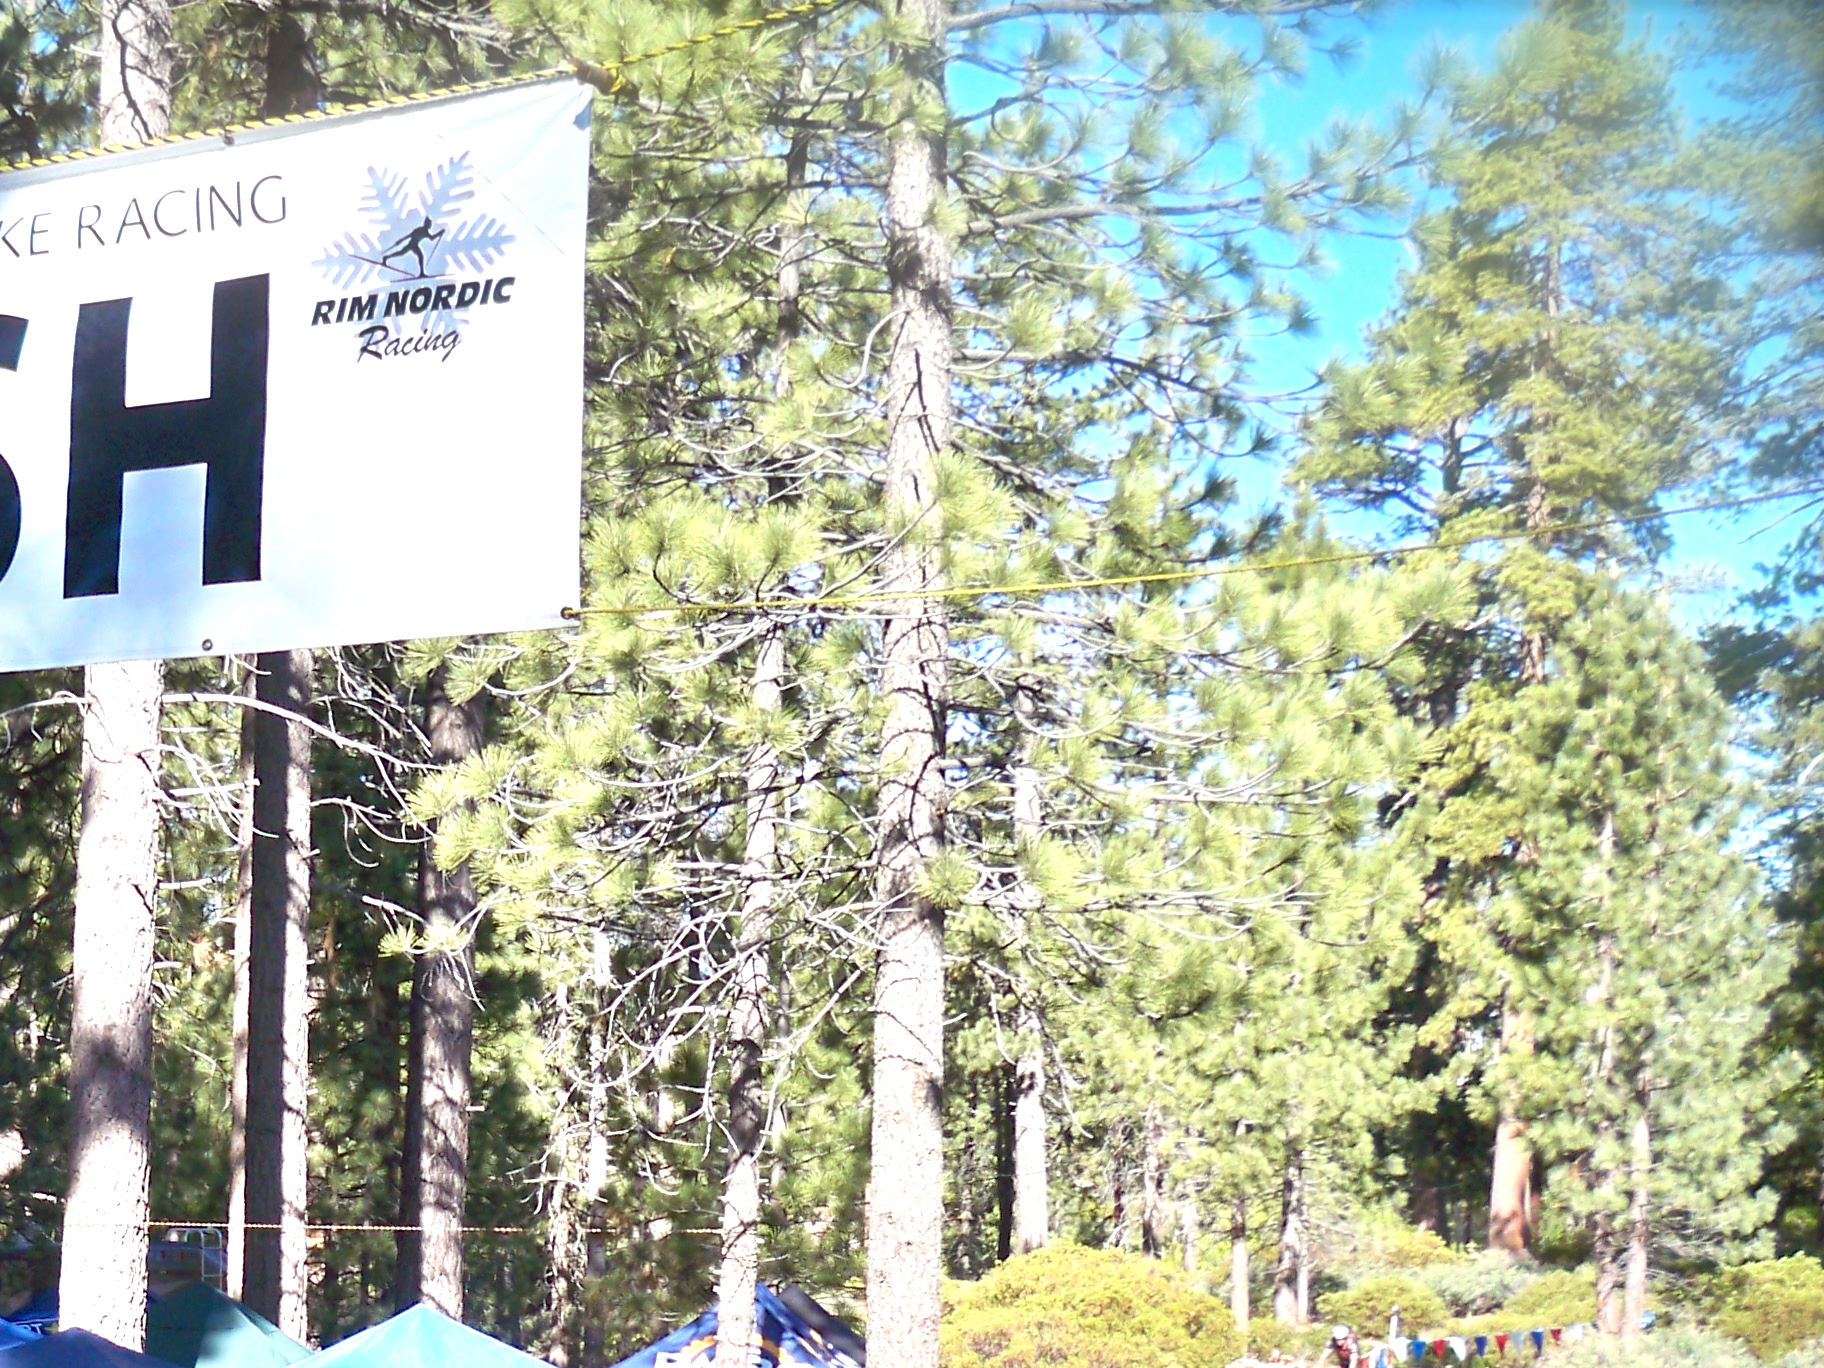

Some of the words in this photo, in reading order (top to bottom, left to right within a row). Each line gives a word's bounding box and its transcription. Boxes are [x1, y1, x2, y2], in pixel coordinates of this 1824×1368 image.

[76, 174, 288, 249] RACING
[311, 294, 379, 326] RIM
[383, 277, 516, 318] NORDIC
[357, 325, 462, 363] Racing
